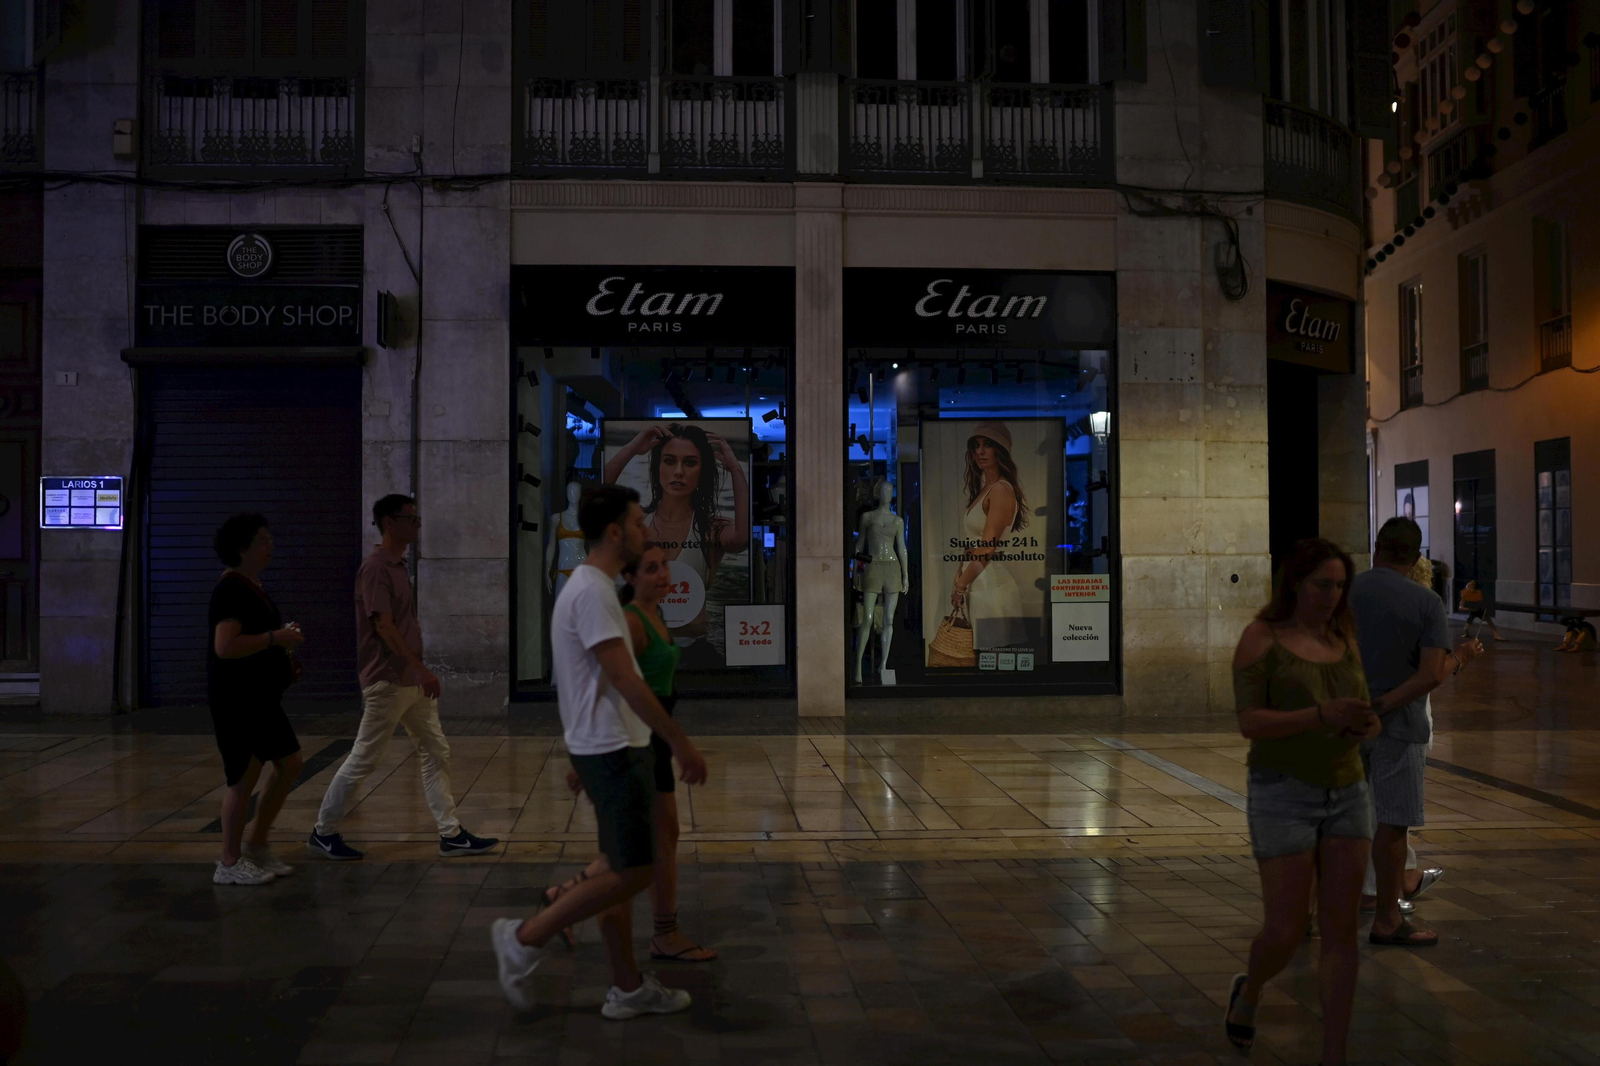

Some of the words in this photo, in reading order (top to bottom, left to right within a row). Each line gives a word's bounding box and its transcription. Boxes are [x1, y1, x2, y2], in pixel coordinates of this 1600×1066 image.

[241, 246, 257, 254] THE
[236, 254, 264, 262] BODY
[237, 261, 263, 270] SHOP
[586, 276, 724, 316] Etam
[914, 279, 1048, 318] Etam
[143, 305, 194, 326] THE
[203, 305, 276, 326] BODY
[1285, 298, 1341, 341] Etam
[627, 322, 682, 333] PARIS
[955, 324, 1008, 334] PARIS
[1300, 341, 1324, 354] PARIS
[61, 480, 97, 489] LARIOS
[99, 480, 104, 489] 1
[949, 537, 1010, 549] Sujetador
[1012, 537, 1028, 547] 24
[1030, 536, 1038, 547] h
[943, 551, 989, 562] confort
[991, 550, 1045, 561] absoluto
[739, 620, 771, 636] 3x2
[1062, 633, 1099, 641] colección
